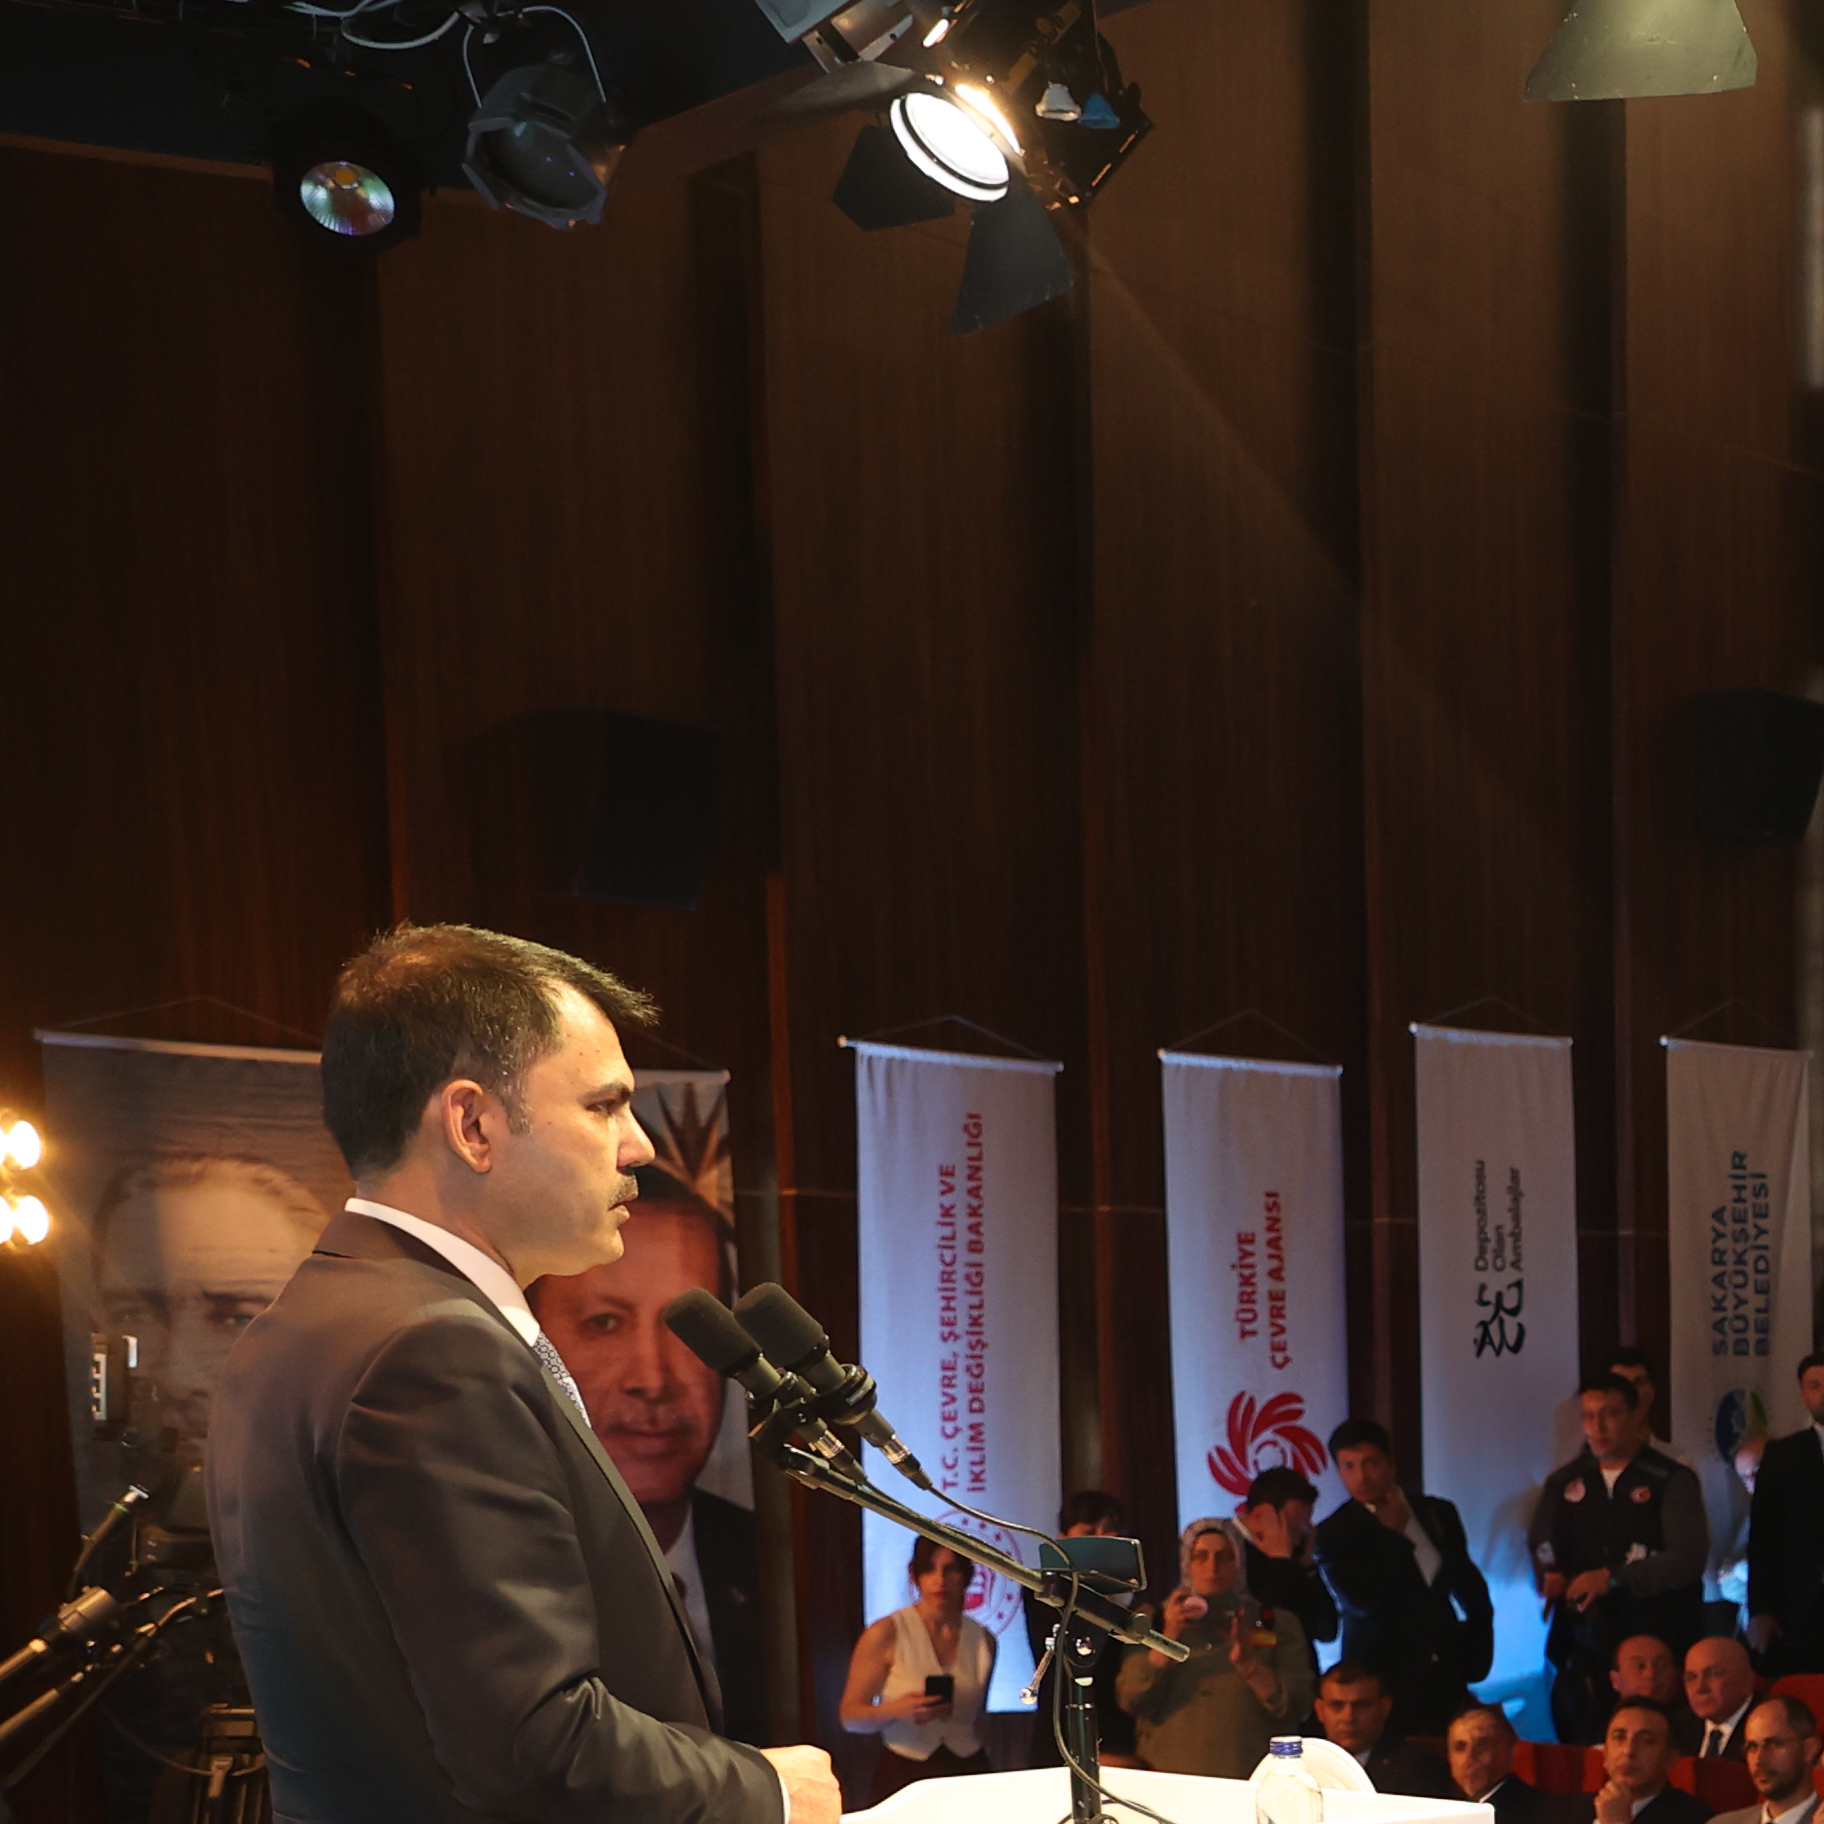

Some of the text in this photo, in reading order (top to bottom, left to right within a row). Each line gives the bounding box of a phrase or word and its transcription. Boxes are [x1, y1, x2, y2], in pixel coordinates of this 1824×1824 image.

[935, 1164, 963, 1491] T.C. ÇEVRE, ŞEHİRCİLİK VE
[962, 1112, 989, 1492] İKLİM DEĞİŞİKLİĞİ BAKANLIĞI
[1229, 1231, 1259, 1342] TÜRKİYE
[1264, 1191, 1294, 1371] ÇEVRE AJANSI
[1710, 1205, 1729, 1357] SAKARYA
[1750, 1172, 1770, 1357] BELEDİYESİ
